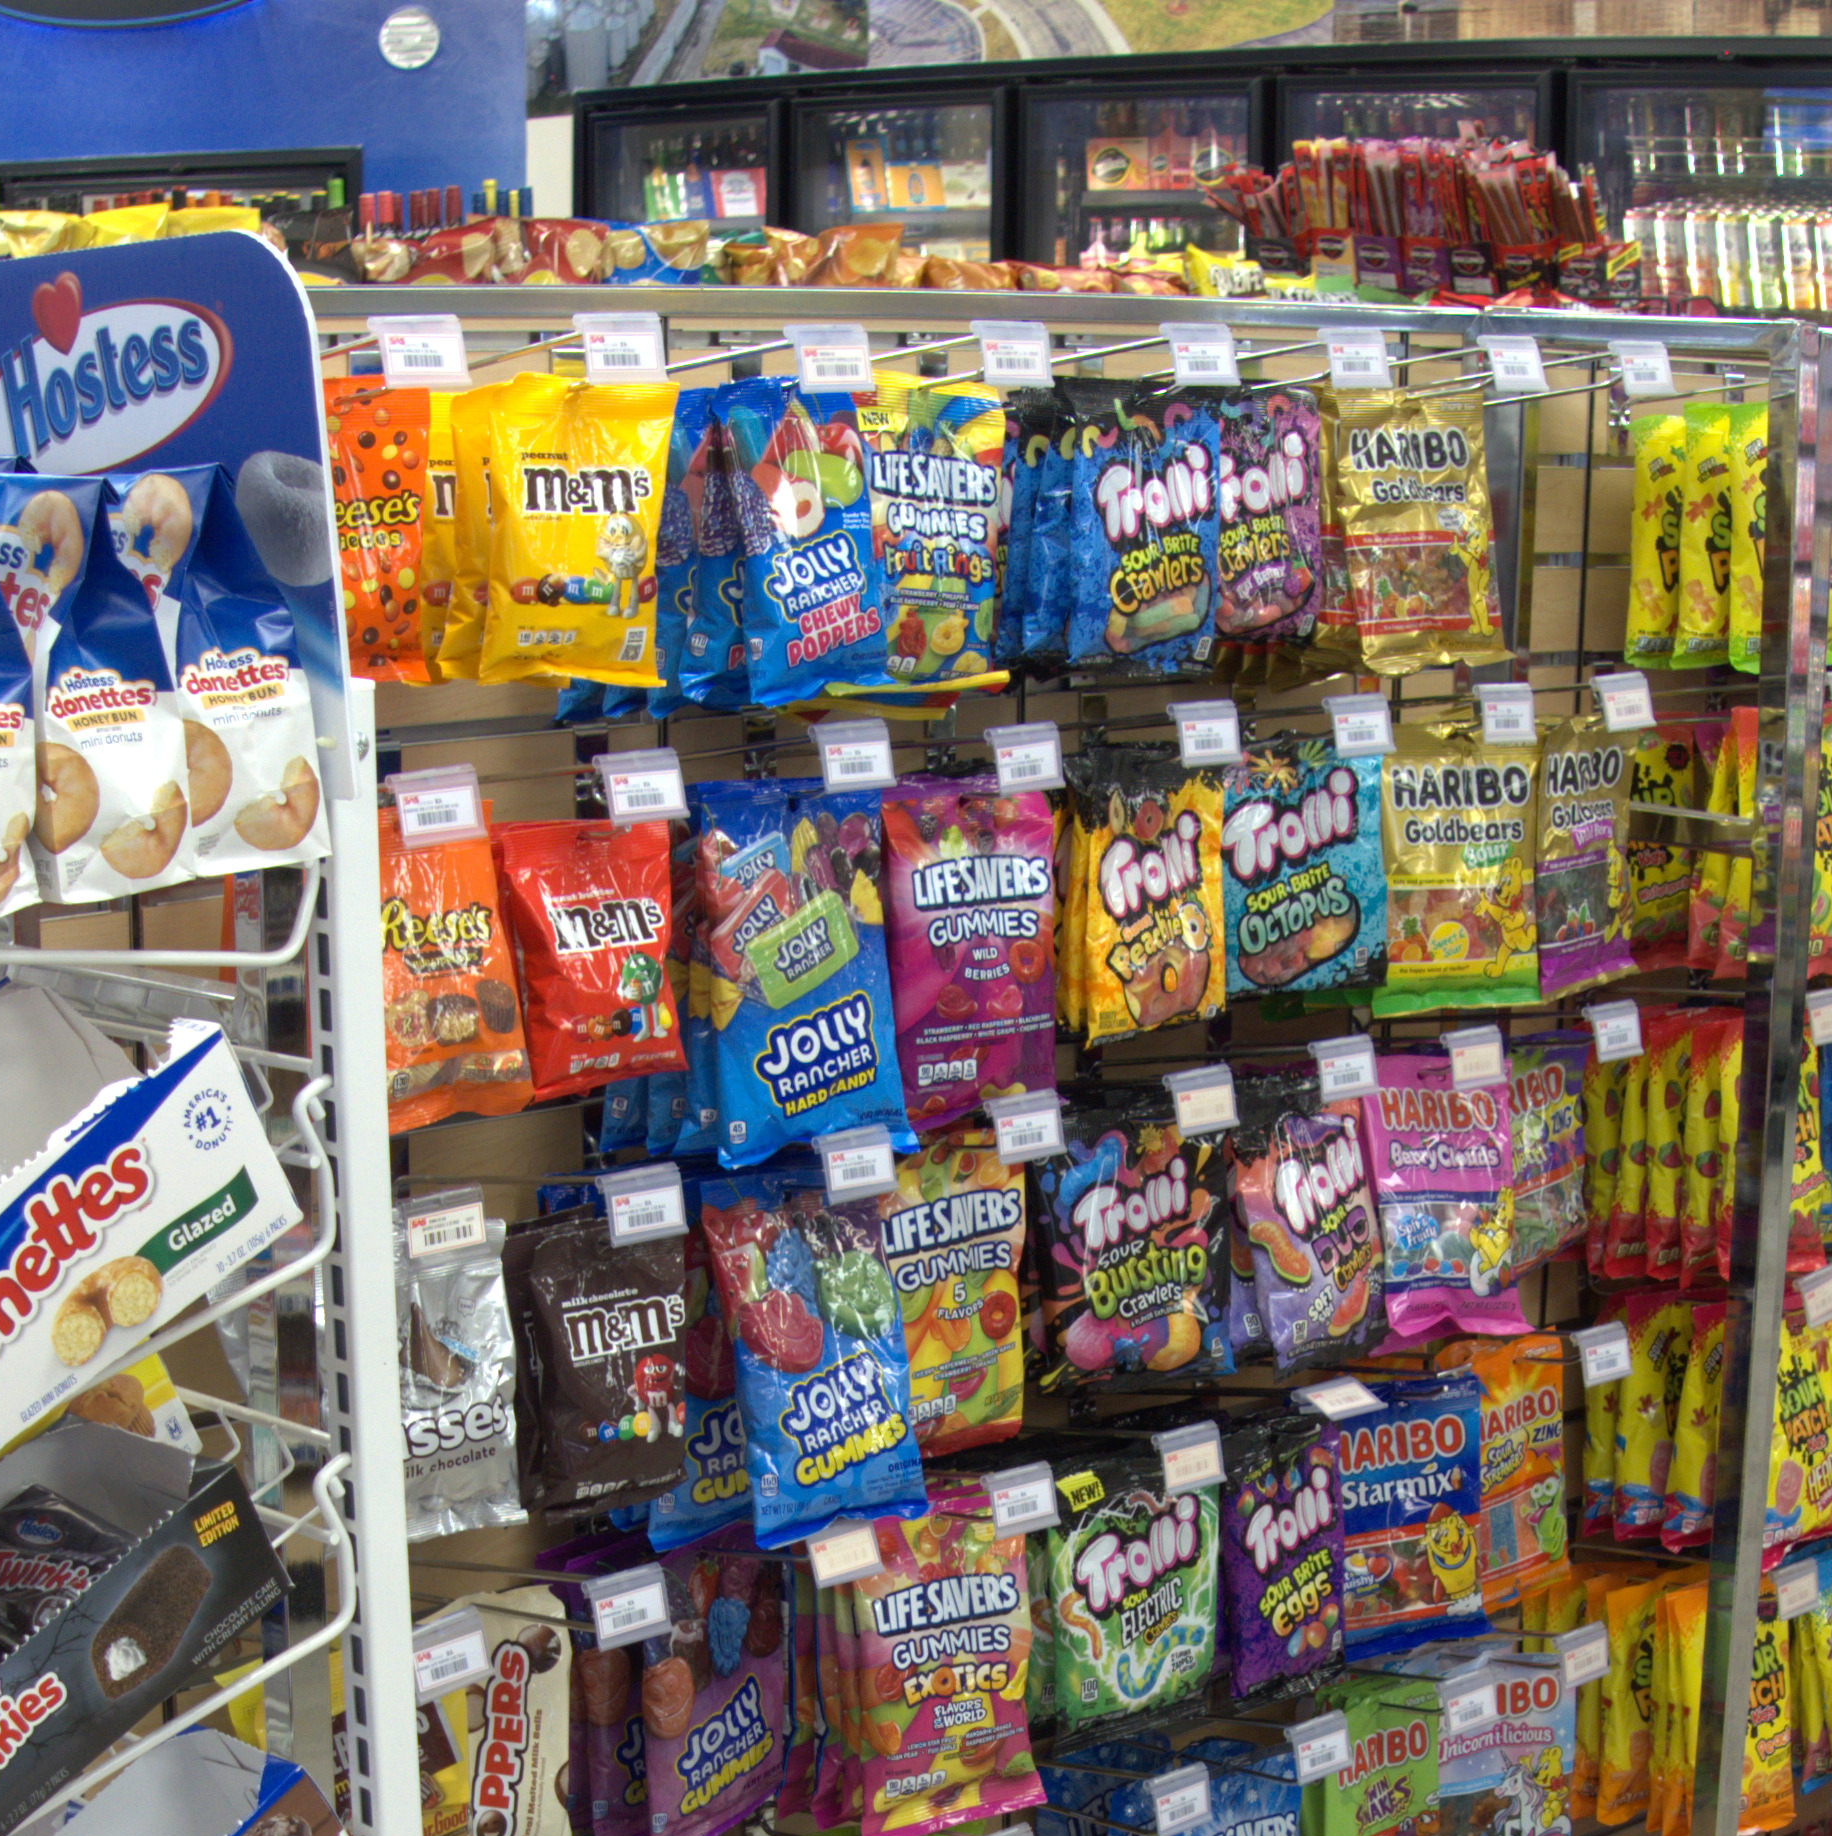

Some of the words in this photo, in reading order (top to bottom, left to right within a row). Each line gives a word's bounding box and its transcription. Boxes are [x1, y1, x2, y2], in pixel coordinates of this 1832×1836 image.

[1, 318, 212, 455] Hostess
[860, 411, 892, 428] NEW
[521, 451, 568, 462] peanut
[1350, 428, 1467, 471] HARIBO
[1098, 445, 1210, 541] Trolli
[1372, 482, 1466, 503] Goldbears
[1109, 554, 1203, 613] Crawlers
[799, 595, 860, 632] CHEWY
[787, 608, 881, 667] POPPERS
[51, 685, 153, 718] donettes
[73, 711, 109, 730] HONEY
[112, 709, 139, 725] BUN
[81, 731, 105, 748] mini
[109, 727, 144, 744] donuts
[1394, 767, 1527, 808] HARIBO
[1223, 770, 1354, 879] Trolli
[1405, 820, 1522, 844] Goldbears
[1102, 813, 1198, 917] Trolli
[1465, 844, 1510, 866] sour
[382, 900, 490, 950] Reese's
[929, 911, 1039, 946] GUMMIES
[1238, 880, 1352, 953] OCTOPUS
[965, 964, 1010, 979] BERRIES
[972, 948, 998, 962] WILD
[764, 1000, 868, 1073] JOLLY
[778, 1047, 872, 1096] RANCHER
[785, 1089, 829, 1115] HARD
[830, 1068, 875, 1101] CANDY
[1379, 1089, 1496, 1131] HARIBO
[194, 1105, 222, 1132] #1
[168, 1194, 237, 1252] Glazed
[897, 1243, 1011, 1289] GUMMIES
[1086, 1243, 1207, 1318] Bursting
[562, 1296, 589, 1309] milk
[589, 1288, 639, 1305] chocolate
[938, 1299, 984, 1321] FLAVORS
[952, 1285, 967, 1302] 5
[1119, 1286, 1182, 1318] Crawlers
[569, 1298, 684, 1359] m&m's
[804, 1402, 886, 1449] RANCHER
[796, 1412, 907, 1487] GUMMIES
[1070, 1481, 1103, 1506] NEW!
[1342, 1468, 1454, 1506] Starmix
[193, 1501, 235, 1533] LIMITED
[198, 1515, 240, 1547] EDITION
[1122, 1579, 1183, 1648] ELECTRIC
[683, 1679, 761, 1763] JOLLY
[934, 1699, 983, 1718] FLAVORS
[946, 1707, 987, 1726] WORLD
